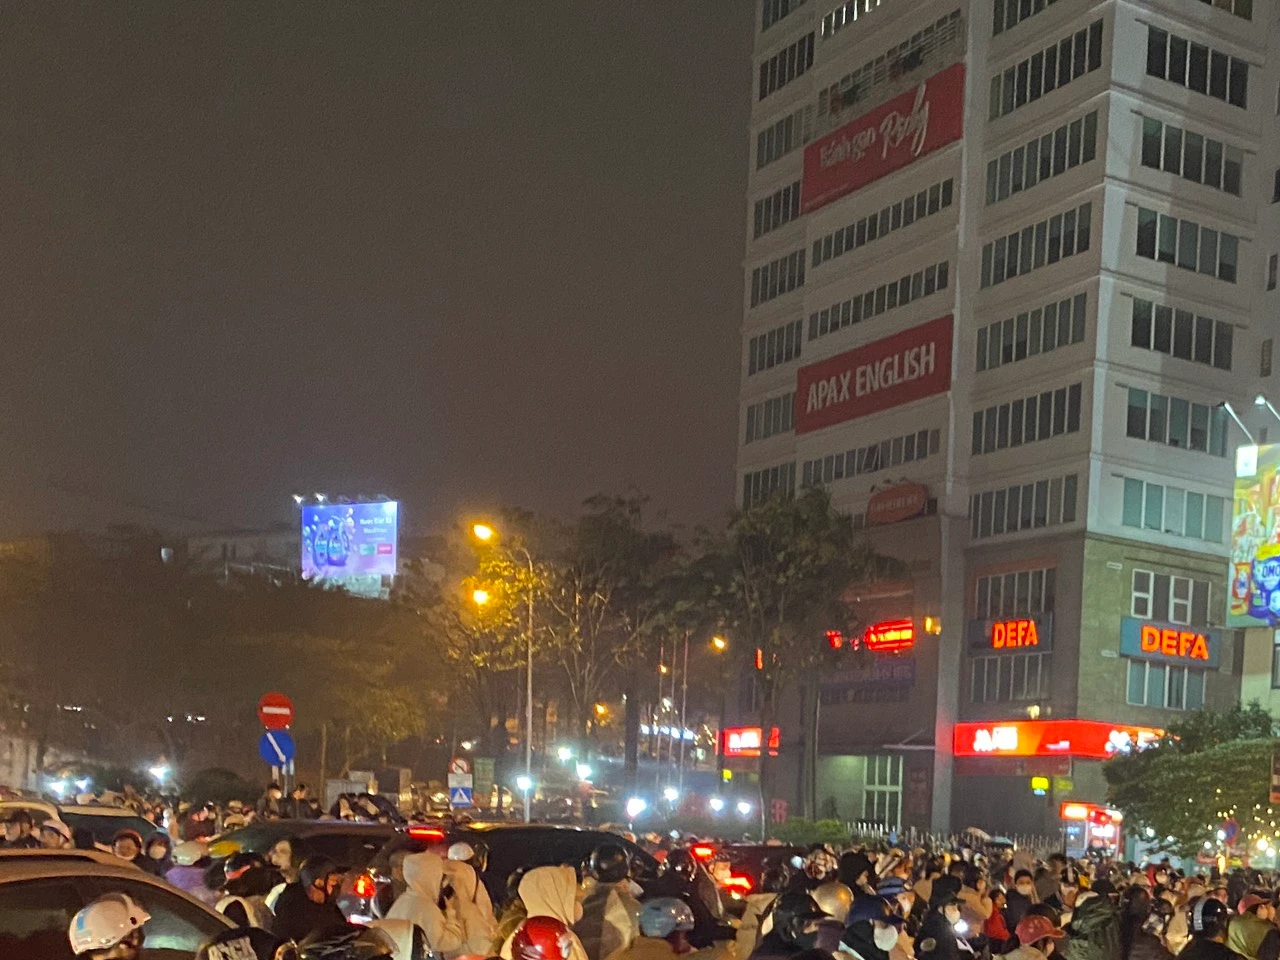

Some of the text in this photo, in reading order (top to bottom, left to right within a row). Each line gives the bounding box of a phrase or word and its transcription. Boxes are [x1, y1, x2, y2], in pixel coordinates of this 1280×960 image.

[807, 342, 936, 414] APAX ENGLISH
[992, 620, 1038, 649] DEFA
[1141, 624, 1209, 660] DEFA
